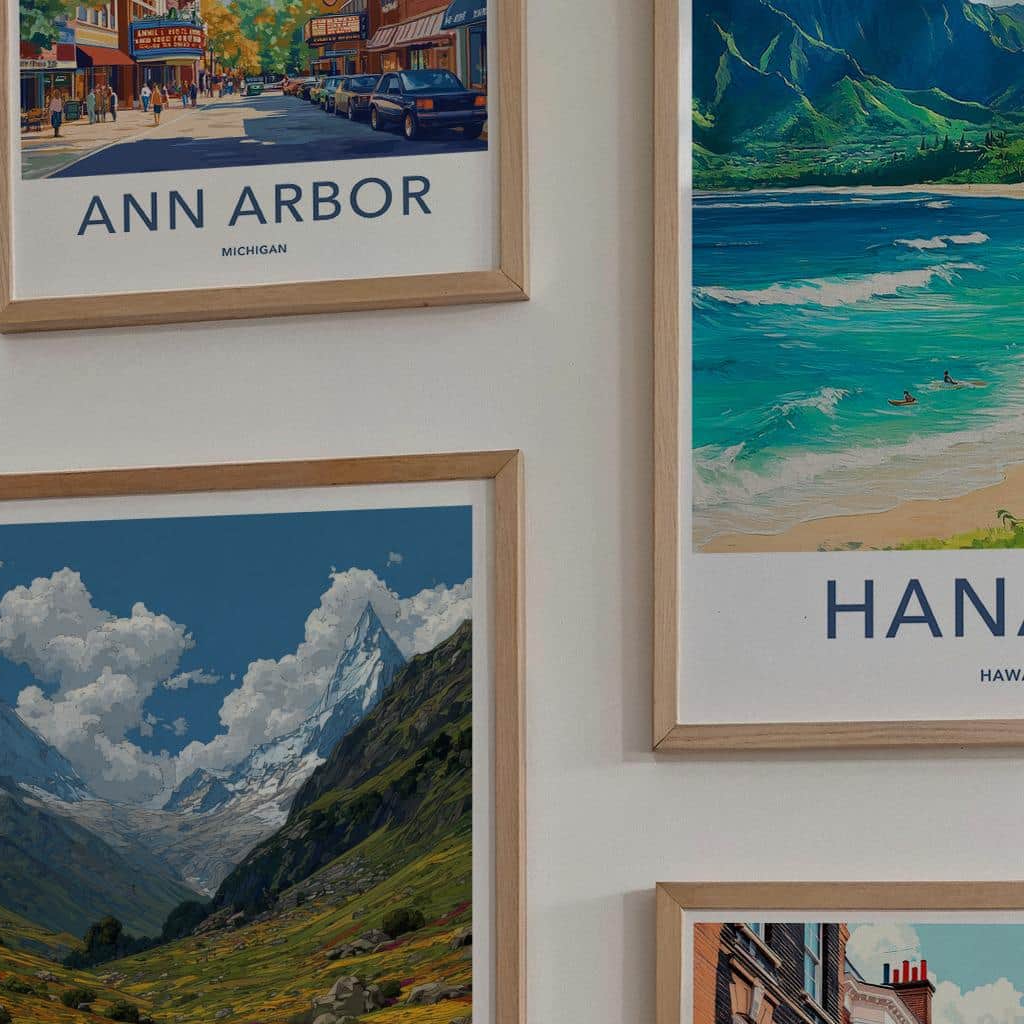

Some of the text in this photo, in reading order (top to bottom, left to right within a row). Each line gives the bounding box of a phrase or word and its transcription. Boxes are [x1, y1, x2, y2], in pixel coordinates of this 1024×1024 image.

[76, 175, 432, 236] ANN ARBOR
[221, 243, 288, 257] MICHIGAN
[826, 577, 1024, 639] HAN
[980, 668, 1024, 682] HAW
